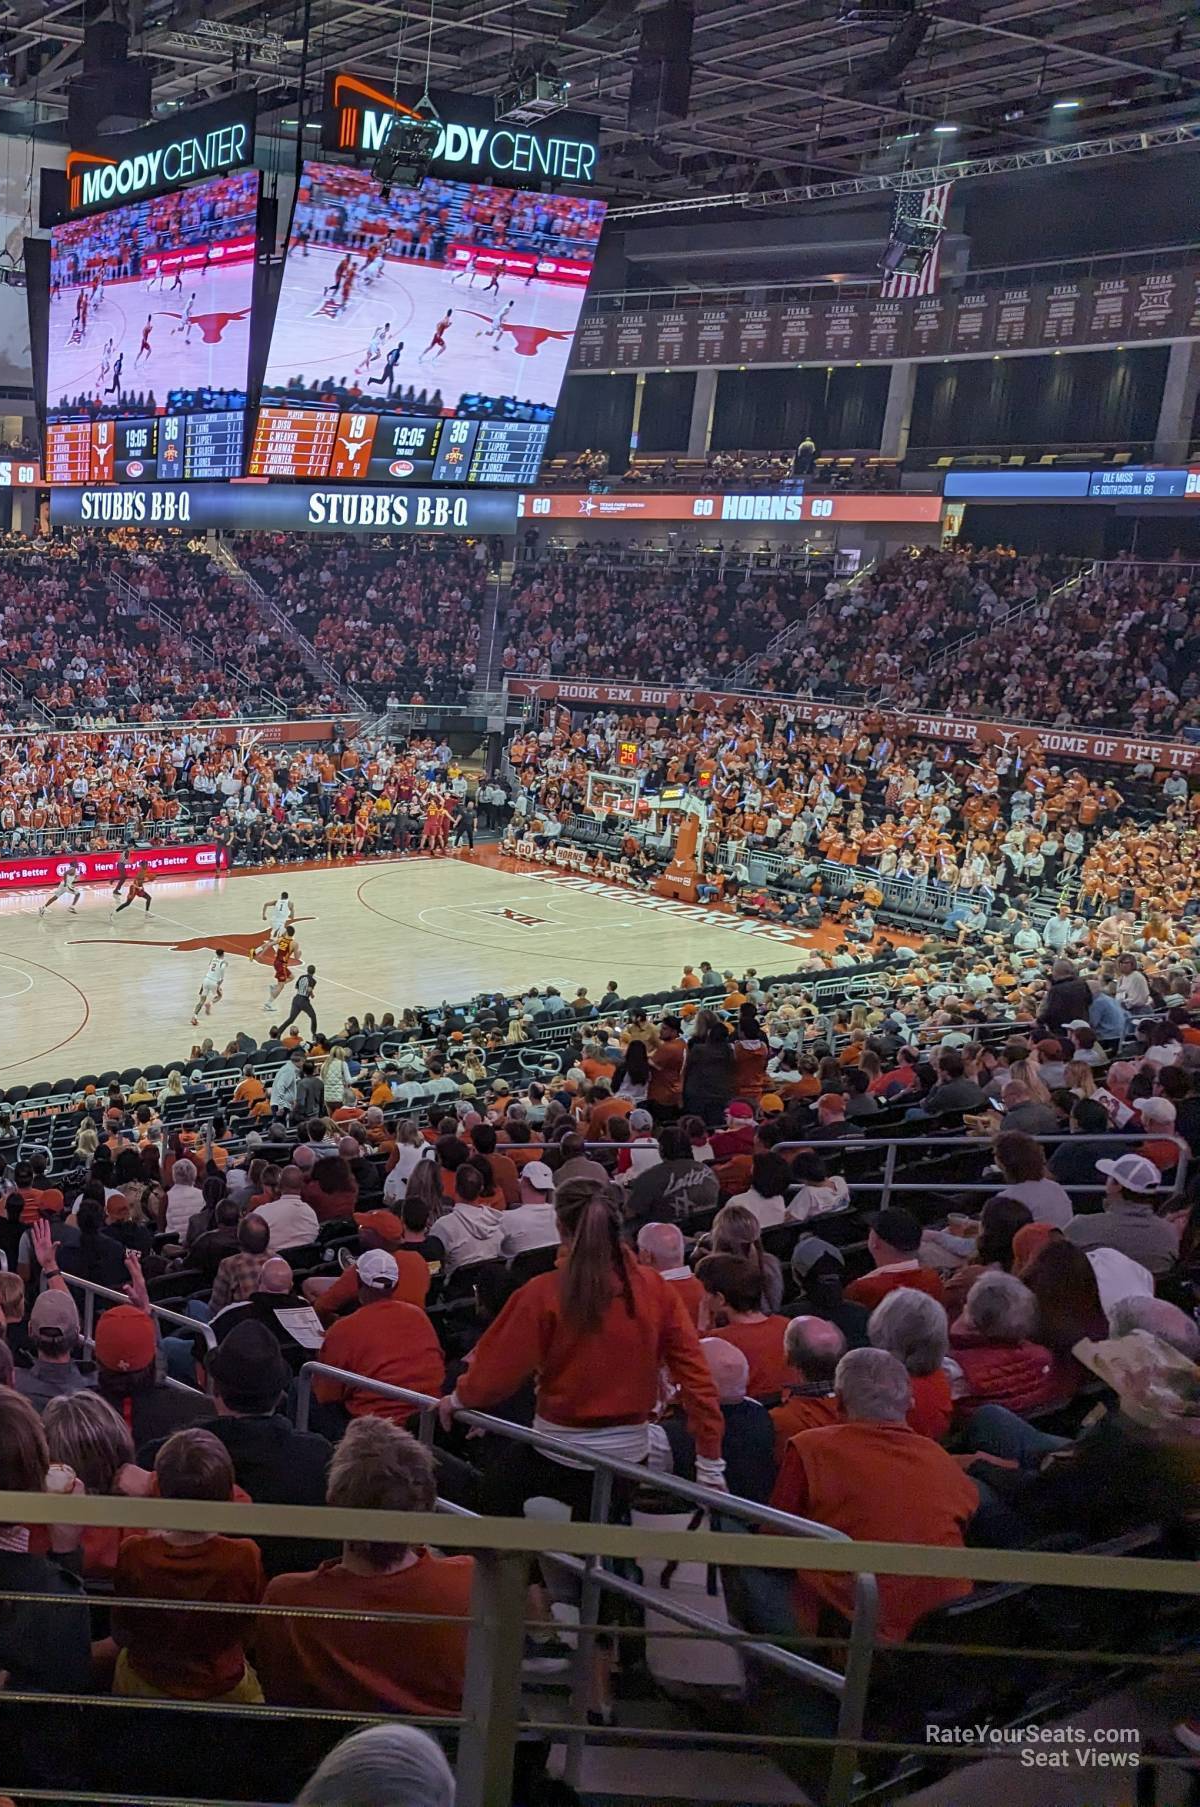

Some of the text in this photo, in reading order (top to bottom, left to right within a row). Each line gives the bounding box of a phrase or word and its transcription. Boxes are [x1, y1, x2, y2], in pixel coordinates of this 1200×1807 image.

[489, 131, 596, 180] CENTER
[82, 123, 247, 206] MOODY CENTER
[98, 423, 108, 444] 19
[165, 418, 178, 440] 36
[349, 415, 366, 438] 19
[450, 421, 469, 443] 36
[126, 429, 147, 448] 19:05
[393, 427, 426, 446] 19:05
[18, 466, 34, 484] GO
[1103, 473, 1133, 483] OLE MISS
[1145, 472, 1155, 483] 65
[1092, 485, 1142, 496] 15 SOUTH CAROLINA
[1169, 486, 1175, 495] F
[81, 490, 146, 521] STUBB'S
[308, 492, 408, 526] STUBB'S
[532, 498, 551, 514] GO
[693, 499, 713, 516] GO
[721, 496, 802, 520] HORNS
[811, 500, 833, 517] GO
[558, 685, 598, 699] HOOK
[1038, 734, 1161, 763] HOME OF THE
[621, 752, 634, 764] 29
[518, 843, 531, 855] GO
[557, 850, 584, 862] HORNS
[94, 862, 114, 872] Here
[167, 856, 188, 866] Better
[613, 865, 628, 875] GO
[21, 867, 48, 879] Better
[516, 869, 814, 942] LONGHORNS
[211, 963, 217, 971] 2
